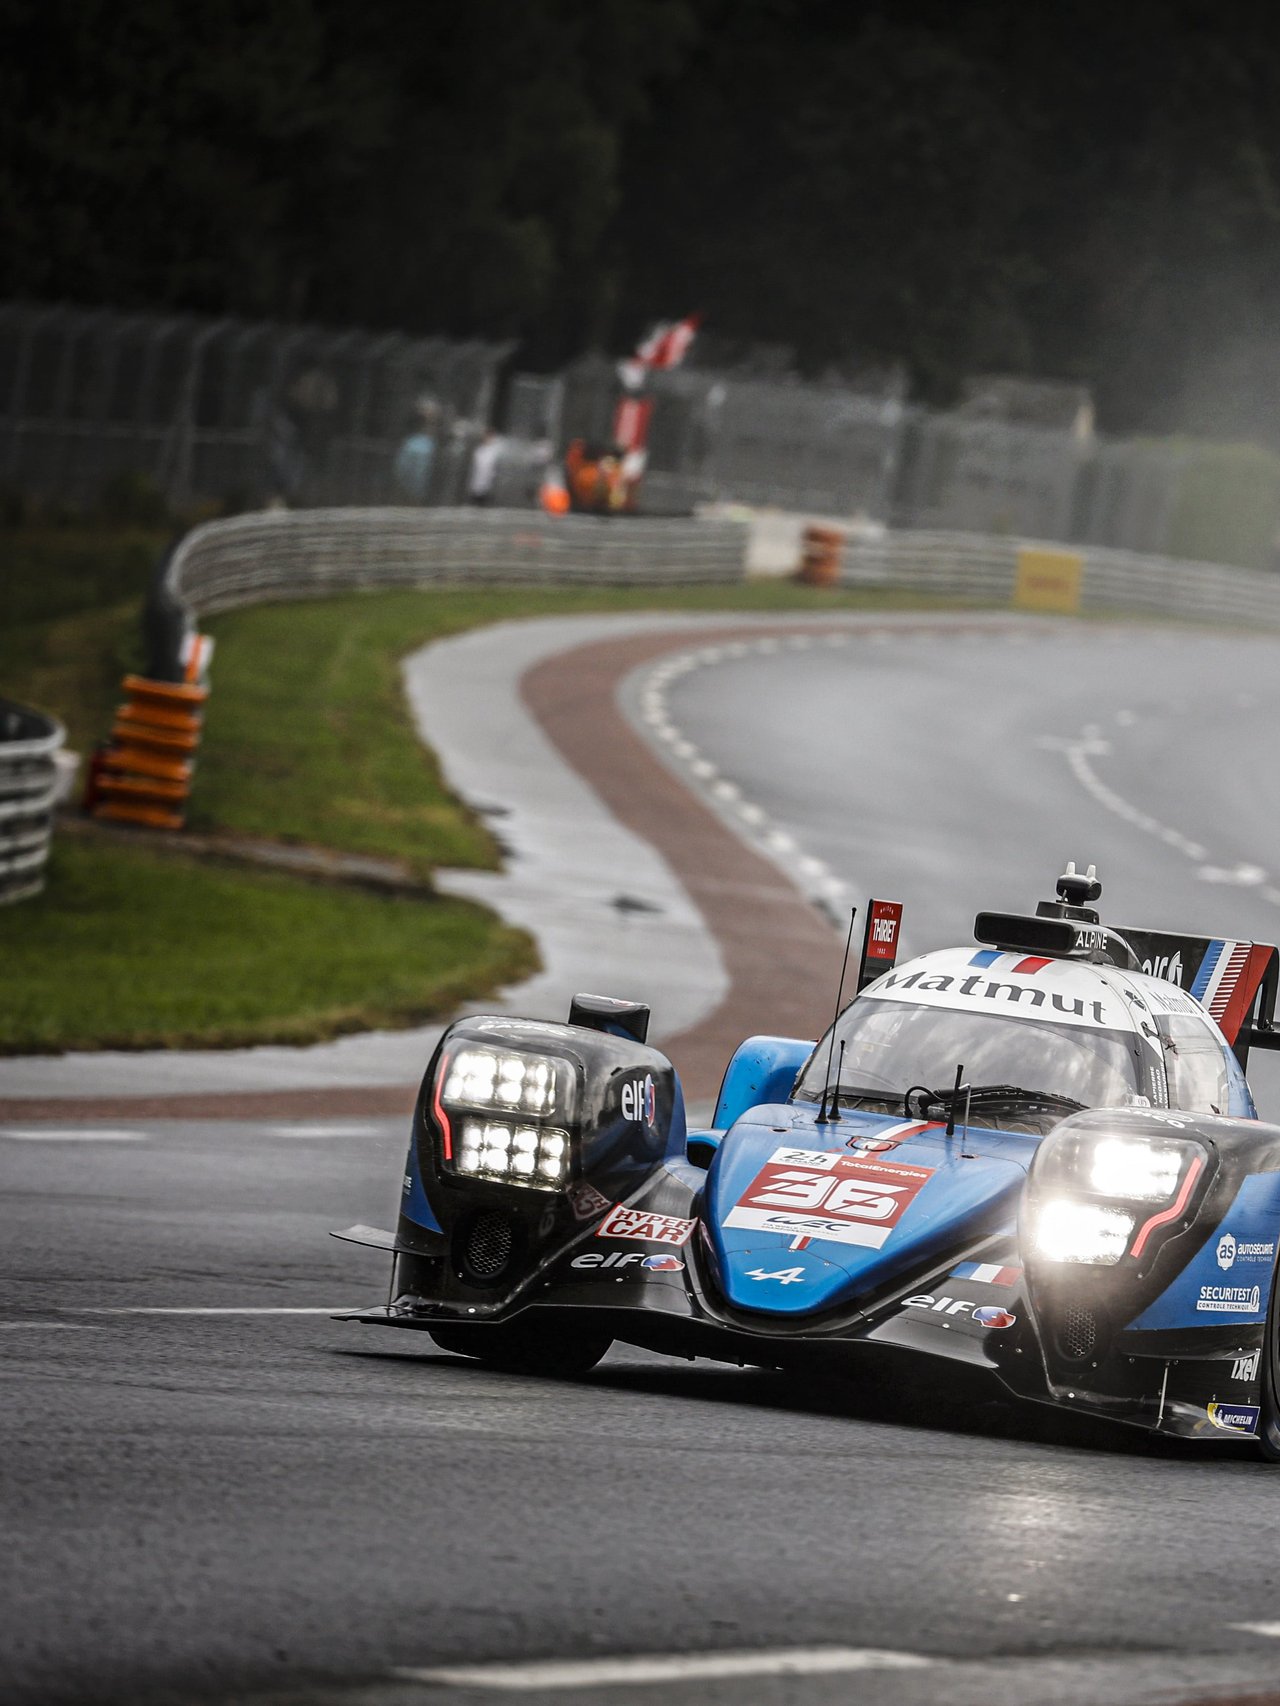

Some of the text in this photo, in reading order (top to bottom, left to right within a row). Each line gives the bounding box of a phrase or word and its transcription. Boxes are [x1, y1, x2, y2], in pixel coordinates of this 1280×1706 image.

[1075, 930, 1108, 950] ALPINE
[872, 971, 1107, 1024] Matmut
[621, 1080, 645, 1121] elf
[841, 1160, 928, 1179] TotalEnergies
[748, 1171, 909, 1220] 36
[615, 1209, 693, 1231] HYPER
[766, 1216, 851, 1231] WEC
[605, 1219, 685, 1242] CAR
[570, 1252, 645, 1269] elf
[1200, 1286, 1252, 1301] SECURITEST
[901, 1294, 976, 1315] elf
[1223, 1414, 1253, 1425] MICHELIN
